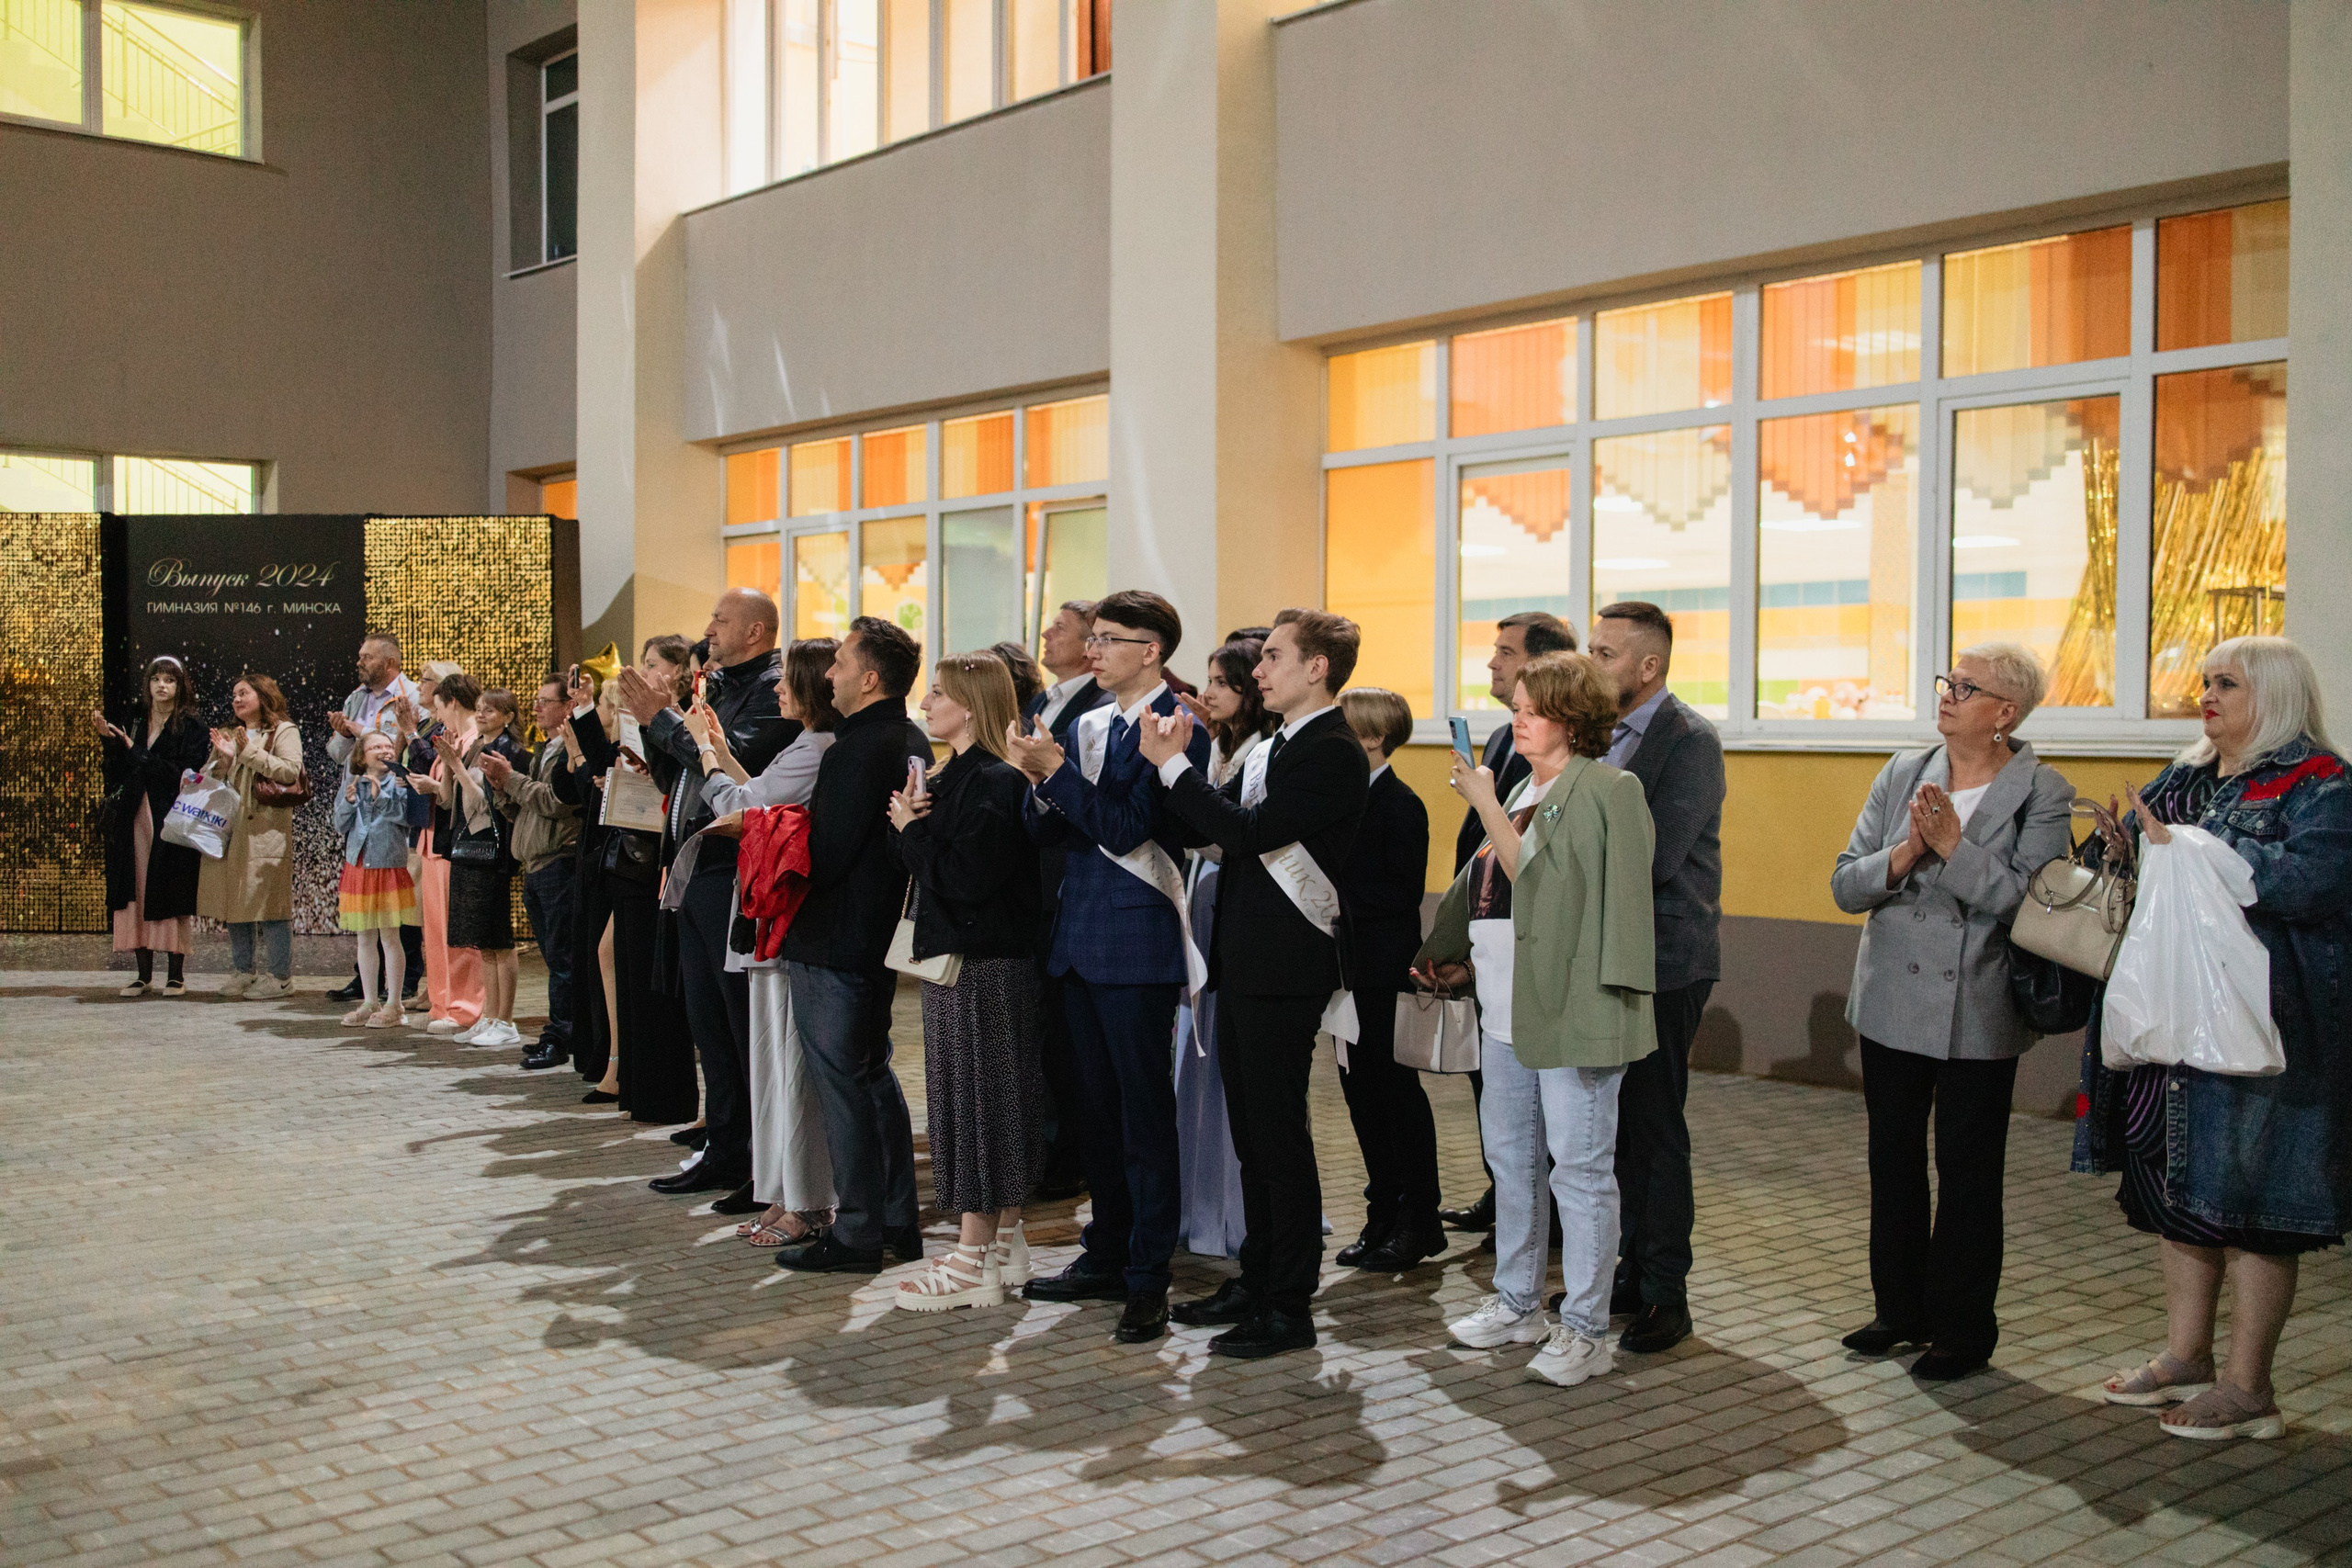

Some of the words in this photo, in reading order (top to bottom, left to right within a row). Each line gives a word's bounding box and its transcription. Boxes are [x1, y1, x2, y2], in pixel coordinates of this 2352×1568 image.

[148, 558, 249, 599] Выпуск
[256, 561, 341, 587] 2024
[147, 602, 218, 614] ГИМНАЗИЯ
[224, 602, 262, 614] №146
[267, 604, 277, 614] г.
[283, 602, 342, 614] МИНСКА
[1310, 890, 1338, 926] 20
